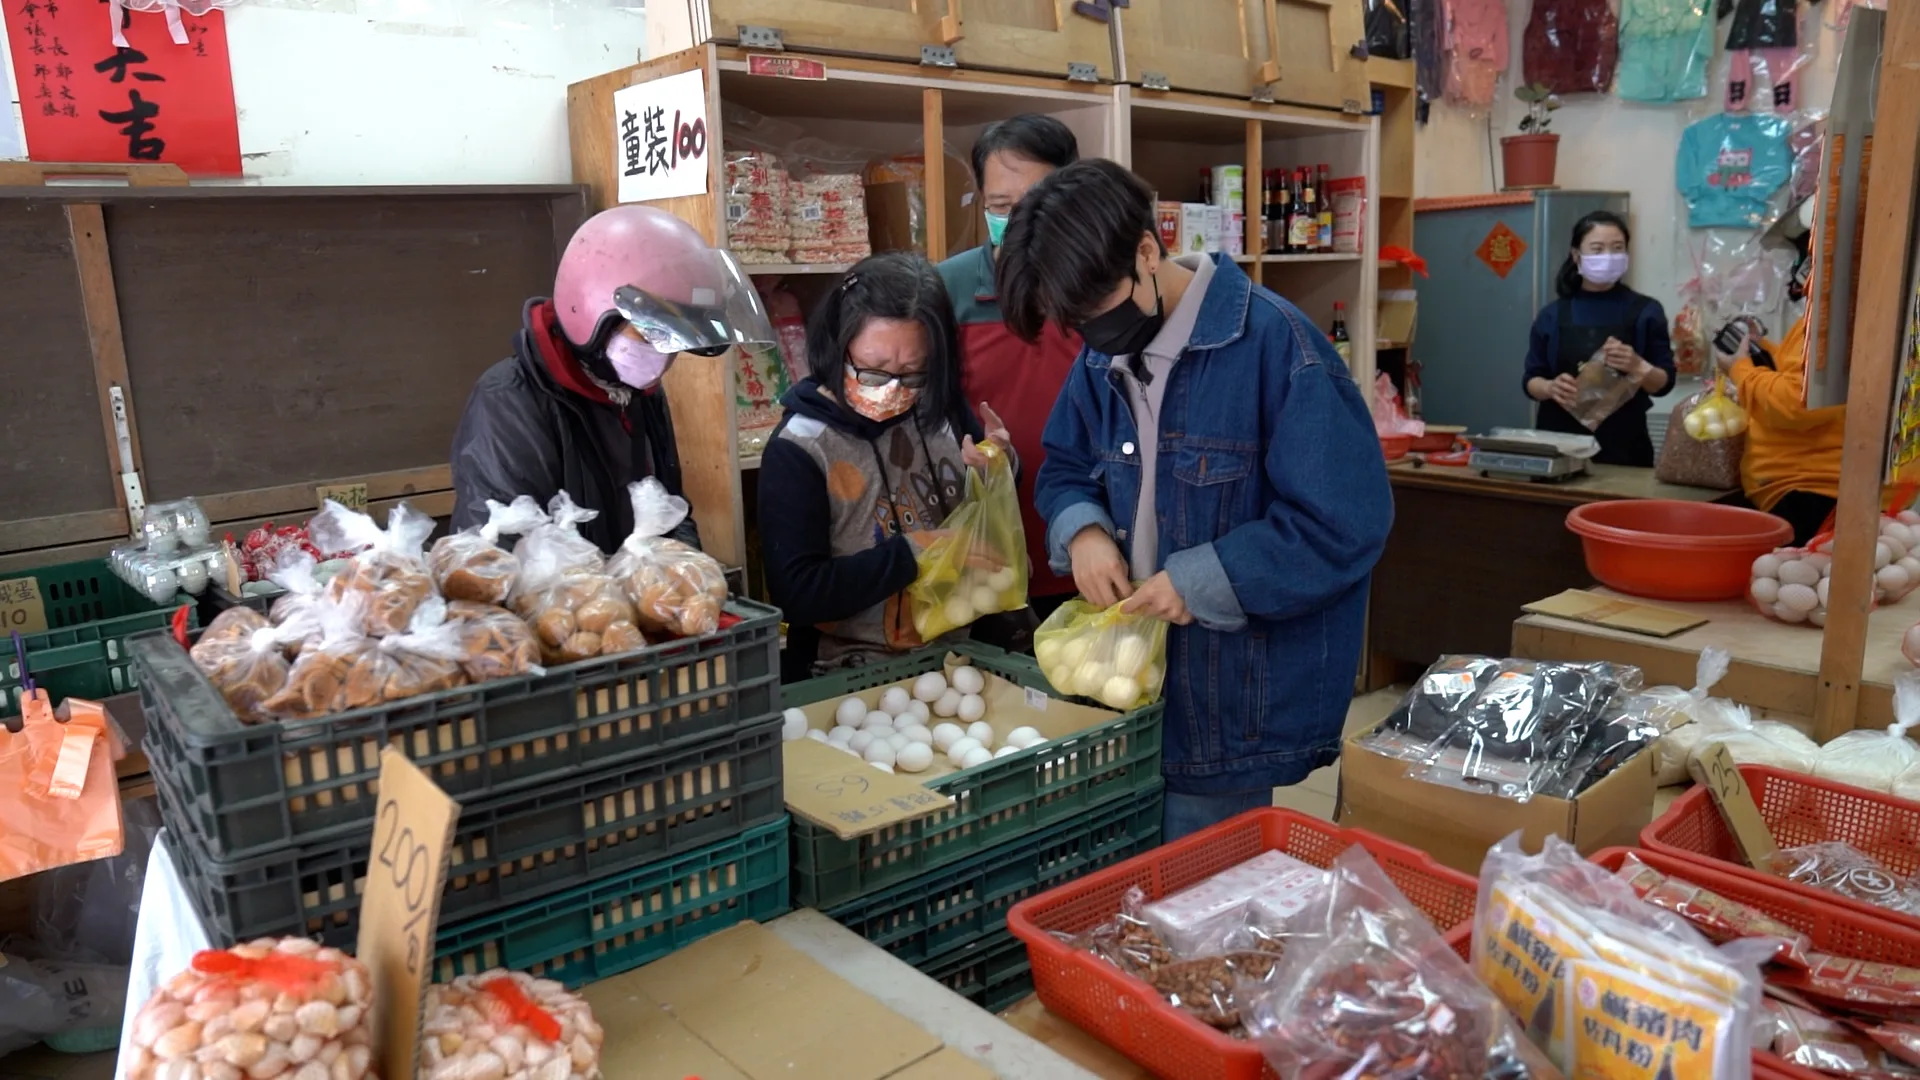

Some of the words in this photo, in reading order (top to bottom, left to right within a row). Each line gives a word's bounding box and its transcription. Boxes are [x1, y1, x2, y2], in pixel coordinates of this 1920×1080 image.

[94, 0, 167, 160] 大吉
[1, 608, 27, 629] 10
[1711, 748, 1740, 798] 25
[1601, 989, 1704, 1052] 鹹豬肉
